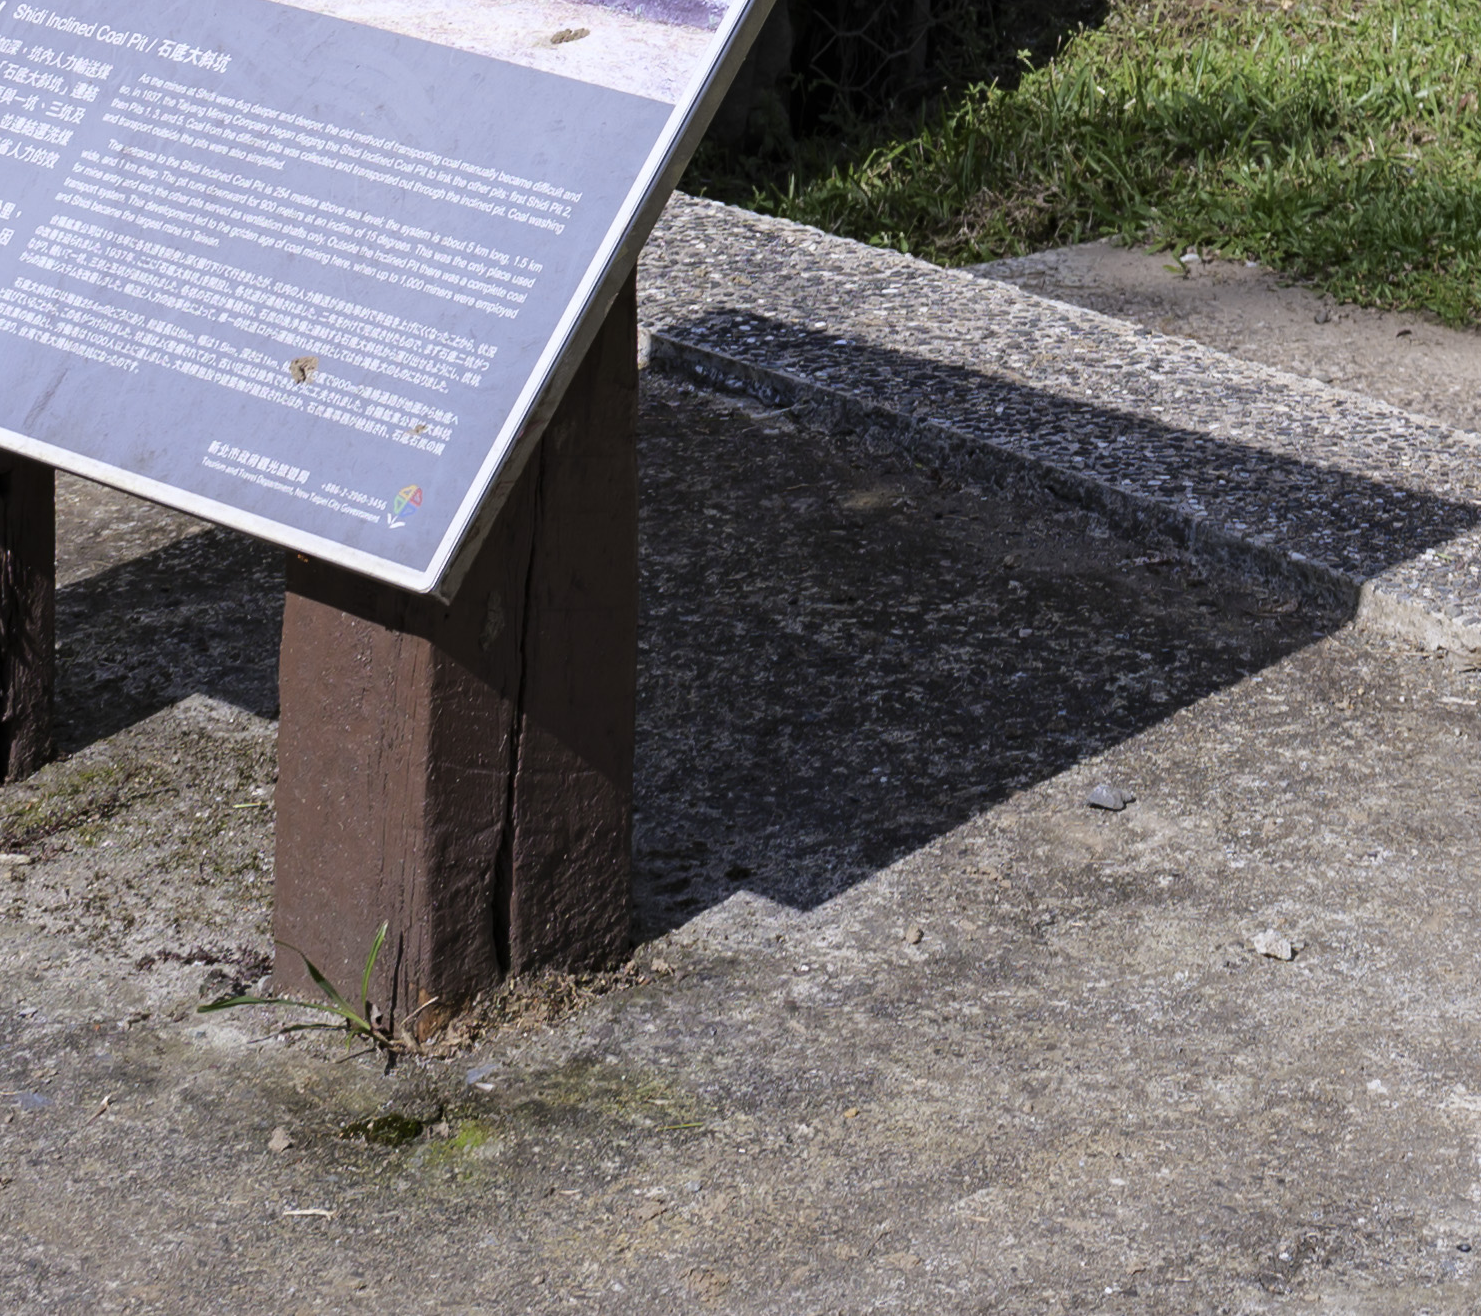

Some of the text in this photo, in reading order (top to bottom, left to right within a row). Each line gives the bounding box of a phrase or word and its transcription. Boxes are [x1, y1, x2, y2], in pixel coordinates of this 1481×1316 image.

[13, 4, 49, 25] Shidi
[45, 12, 98, 37] Inclined
[96, 25, 130, 45] Coal
[126, 33, 148, 51] Pit
[158, 39, 232, 73] 石底大斜坑
[111, 98, 129, 110] then
[128, 102, 145, 114] Pits
[185, 118, 206, 131] Coal
[204, 123, 223, 136] from
[236, 133, 269, 149] different
[266, 142, 283, 153] pits
[283, 147, 300, 158] was
[300, 152, 338, 168] collected
[352, 165, 401, 185] transported
[398, 179, 415, 190] out
[413, 182, 446, 199] through
[459, 194, 495, 212] inclined
[508, 208, 530, 222] Coal
[528, 216, 565, 235] washing
[117, 116, 153, 133] transport
[152, 127, 180, 141] outside
[192, 138, 209, 149] pits
[208, 144, 229, 155] were
[228, 148, 247, 159] also
[163, 81, 187, 94] mines
[195, 88, 216, 101] Shidi
[215, 96, 235, 107] were
[235, 99, 252, 113] dug
[250, 104, 280, 118] deeper
[339, 129, 354, 139] old
[352, 133, 386, 148] method
[393, 143, 442, 166] transporting
[441, 157, 462, 168] coal
[459, 163, 499, 181] manually
[498, 171, 533, 189] became
[532, 181, 564, 197] difficult
[177, 99, 207, 117] Taiyang
[206, 107, 233, 124] Mining
[232, 115, 271, 134] Company
[269, 124, 296, 140] began
[295, 133, 326, 150] digging
[339, 144, 363, 158] Shidi
[361, 150, 395, 167] Inclined
[394, 159, 416, 173] Coal
[414, 164, 428, 176] Pit
[436, 171, 453, 184] link
[467, 181, 491, 194] other
[509, 191, 527, 204] first
[526, 196, 550, 211] Shidi
[549, 202, 564, 215] Pit
[64, 177, 99, 194] transport
[128, 194, 145, 207] This
[144, 201, 195, 222] development
[193, 214, 209, 226] led
[229, 227, 259, 241] golden
[258, 235, 275, 247] age
[284, 243, 304, 254] coal
[302, 248, 331, 265] mining
[353, 263, 377, 276] when
[400, 275, 424, 290] 1,000
[423, 284, 453, 299] miners
[453, 293, 475, 306] were
[475, 300, 519, 319] employed
[71, 195, 91, 208] Shidi
[90, 201, 122, 218] became
[135, 214, 163, 230] largest
[162, 224, 182, 236] mine
[83, 167, 103, 179] mine
[102, 173, 124, 186] entry
[168, 192, 190, 203] other
[187, 198, 204, 208] pits
[204, 202, 233, 216] served
[242, 214, 283, 231] ventilation
[282, 224, 307, 239] shafts
[327, 236, 360, 254] Outside
[374, 249, 408, 268] Inclined
[406, 259, 420, 272] Pit
[419, 264, 442, 278] there
[441, 272, 460, 284] was
[467, 279, 507, 298] complete
[506, 291, 528, 303] coal
[175, 177, 189, 187] pit
[187, 181, 206, 192] runs
[206, 185, 248, 204] downward
[259, 199, 277, 212] 900
[275, 206, 305, 221] meters
[326, 218, 354, 235] incline
[415, 244, 433, 258] This
[433, 252, 452, 264] was
[467, 262, 487, 276] only
[485, 267, 512, 281] place
[511, 275, 536, 288] used
[180, 160, 202, 173] Shidi
[200, 166, 234, 183] Inclined
[232, 175, 253, 188] Coal
[251, 180, 265, 192] Pit
[272, 186, 291, 199] 254
[290, 193, 319, 208] meters
[318, 201, 345, 215] above
[345, 209, 362, 220] sea
[400, 225, 431, 240] system
[441, 236, 467, 251] about
[514, 255, 529, 268] 1.5
[202, 456, 380, 523] Tourism and Travel Department, New Taipei City Government
